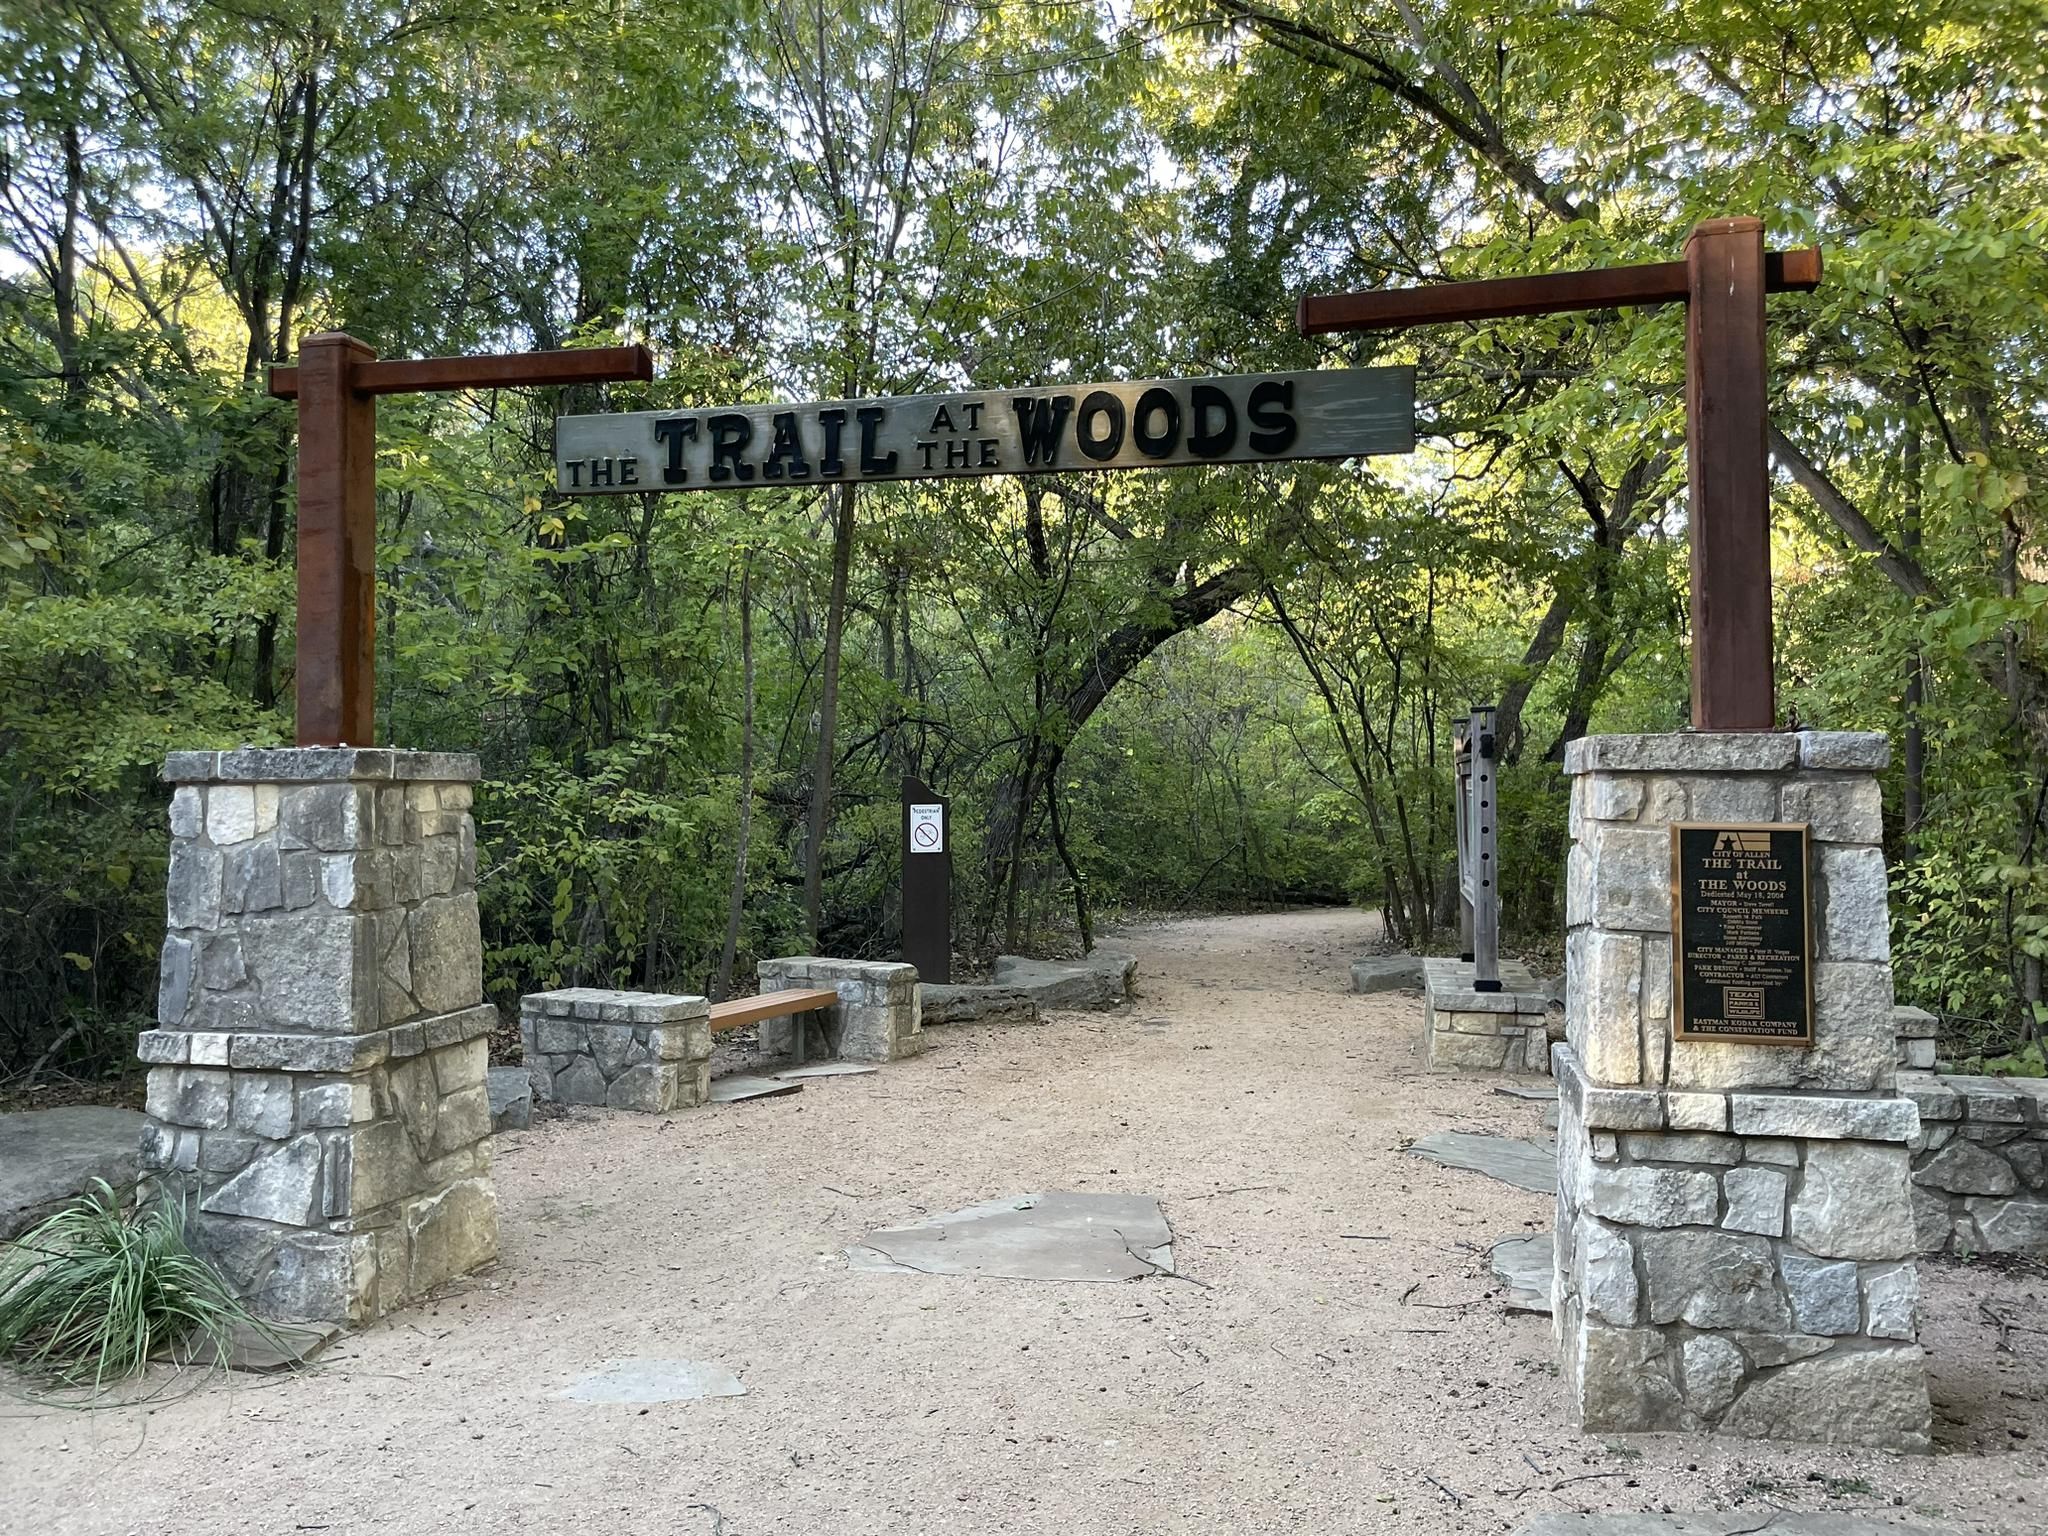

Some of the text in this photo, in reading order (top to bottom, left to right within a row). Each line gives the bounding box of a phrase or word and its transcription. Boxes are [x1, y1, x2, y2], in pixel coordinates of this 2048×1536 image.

[566, 380, 1297, 487] THE TRAIL AT THE WOODS
[1712, 850, 1732, 858] CITY
[1702, 858, 1782, 870] THE TRAIL
[1736, 870, 1748, 880] at
[1698, 879, 1787, 891] THE WOODS
[1700, 890, 1735, 898] Dedicated
[1736, 891, 1752, 900] May
[1699, 971, 1744, 979] CONTRACTOR
[1730, 1019, 1758, 1027] KODAK
[1760, 1020, 1797, 1028] COMPANY
[1718, 1026, 1775, 1034] CONSERVATION
[1777, 1027, 1798, 1035] FUND
